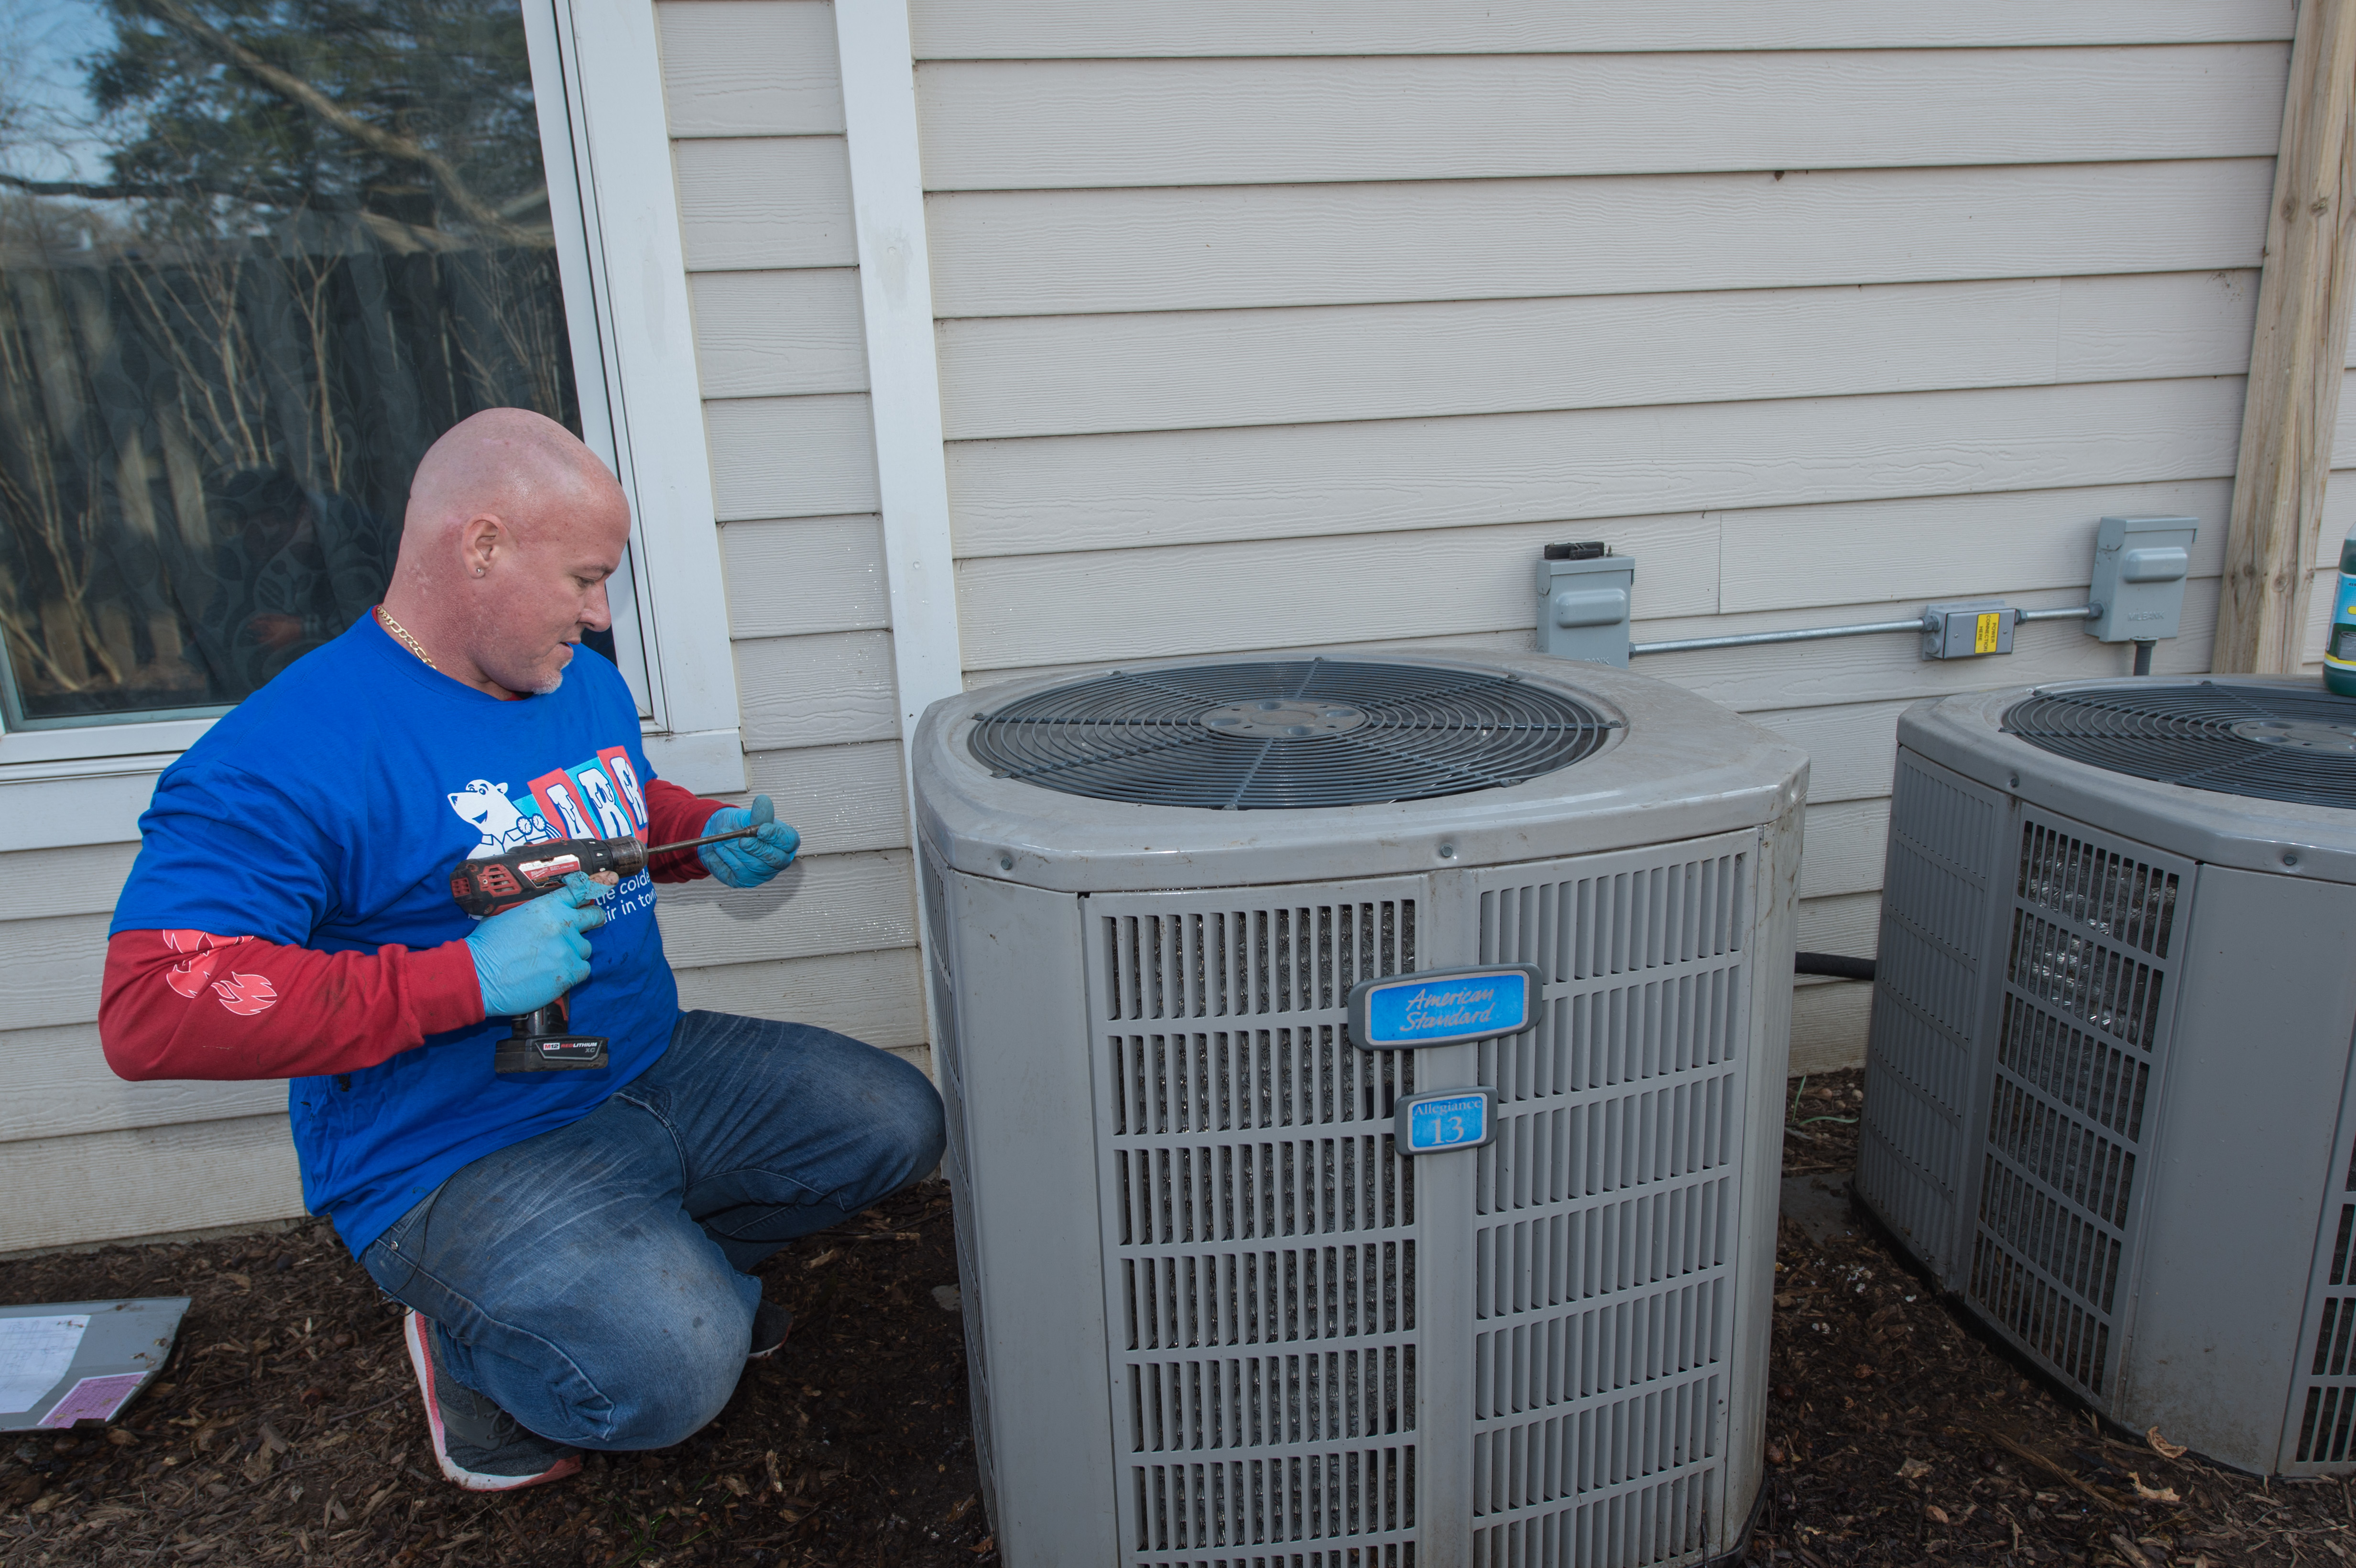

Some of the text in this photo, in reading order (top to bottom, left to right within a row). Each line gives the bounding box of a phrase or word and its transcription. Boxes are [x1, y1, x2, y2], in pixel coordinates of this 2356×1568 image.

[2127, 611, 2165, 621] MILBANK
[604, 905, 617, 925] ir
[621, 900, 637, 915] in
[1406, 987, 1494, 1012] American
[1399, 1002, 1496, 1032] Standard
[1414, 1100, 1482, 1116] Allegiance
[1431, 1116, 1464, 1145] 13
